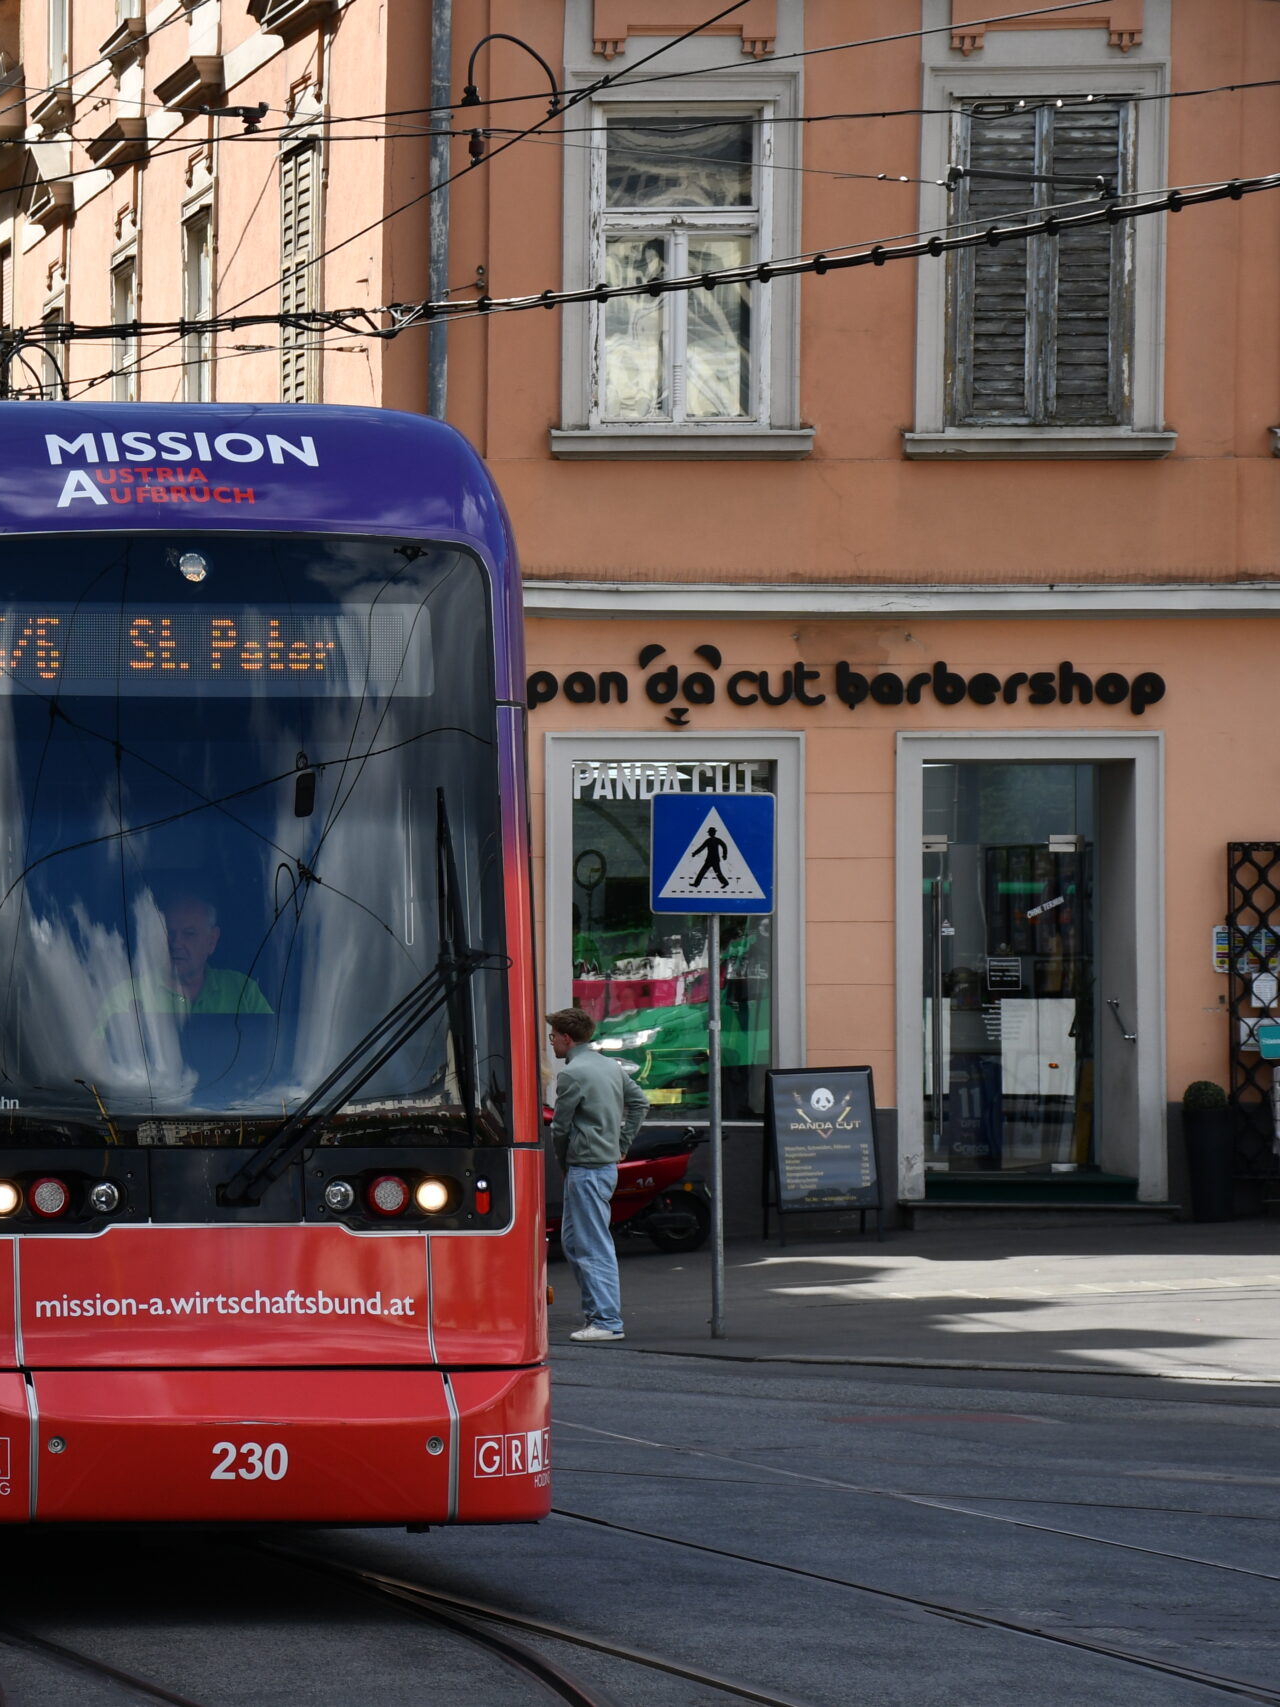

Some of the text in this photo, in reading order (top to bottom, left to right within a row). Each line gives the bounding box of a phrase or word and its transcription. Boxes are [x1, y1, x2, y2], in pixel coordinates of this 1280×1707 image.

[44, 431, 320, 467] MISSION
[129, 618, 190, 670] St.
[211, 619, 336, 670] Peter
[526, 660, 1166, 716] pan da cut barbershop
[572, 763, 760, 800] PANDA CUT
[790, 1119, 862, 1130] PANDA CUT
[35, 1289, 416, 1318] mission-a.wirtschaftsbund.at
[209, 1441, 289, 1481] 230
